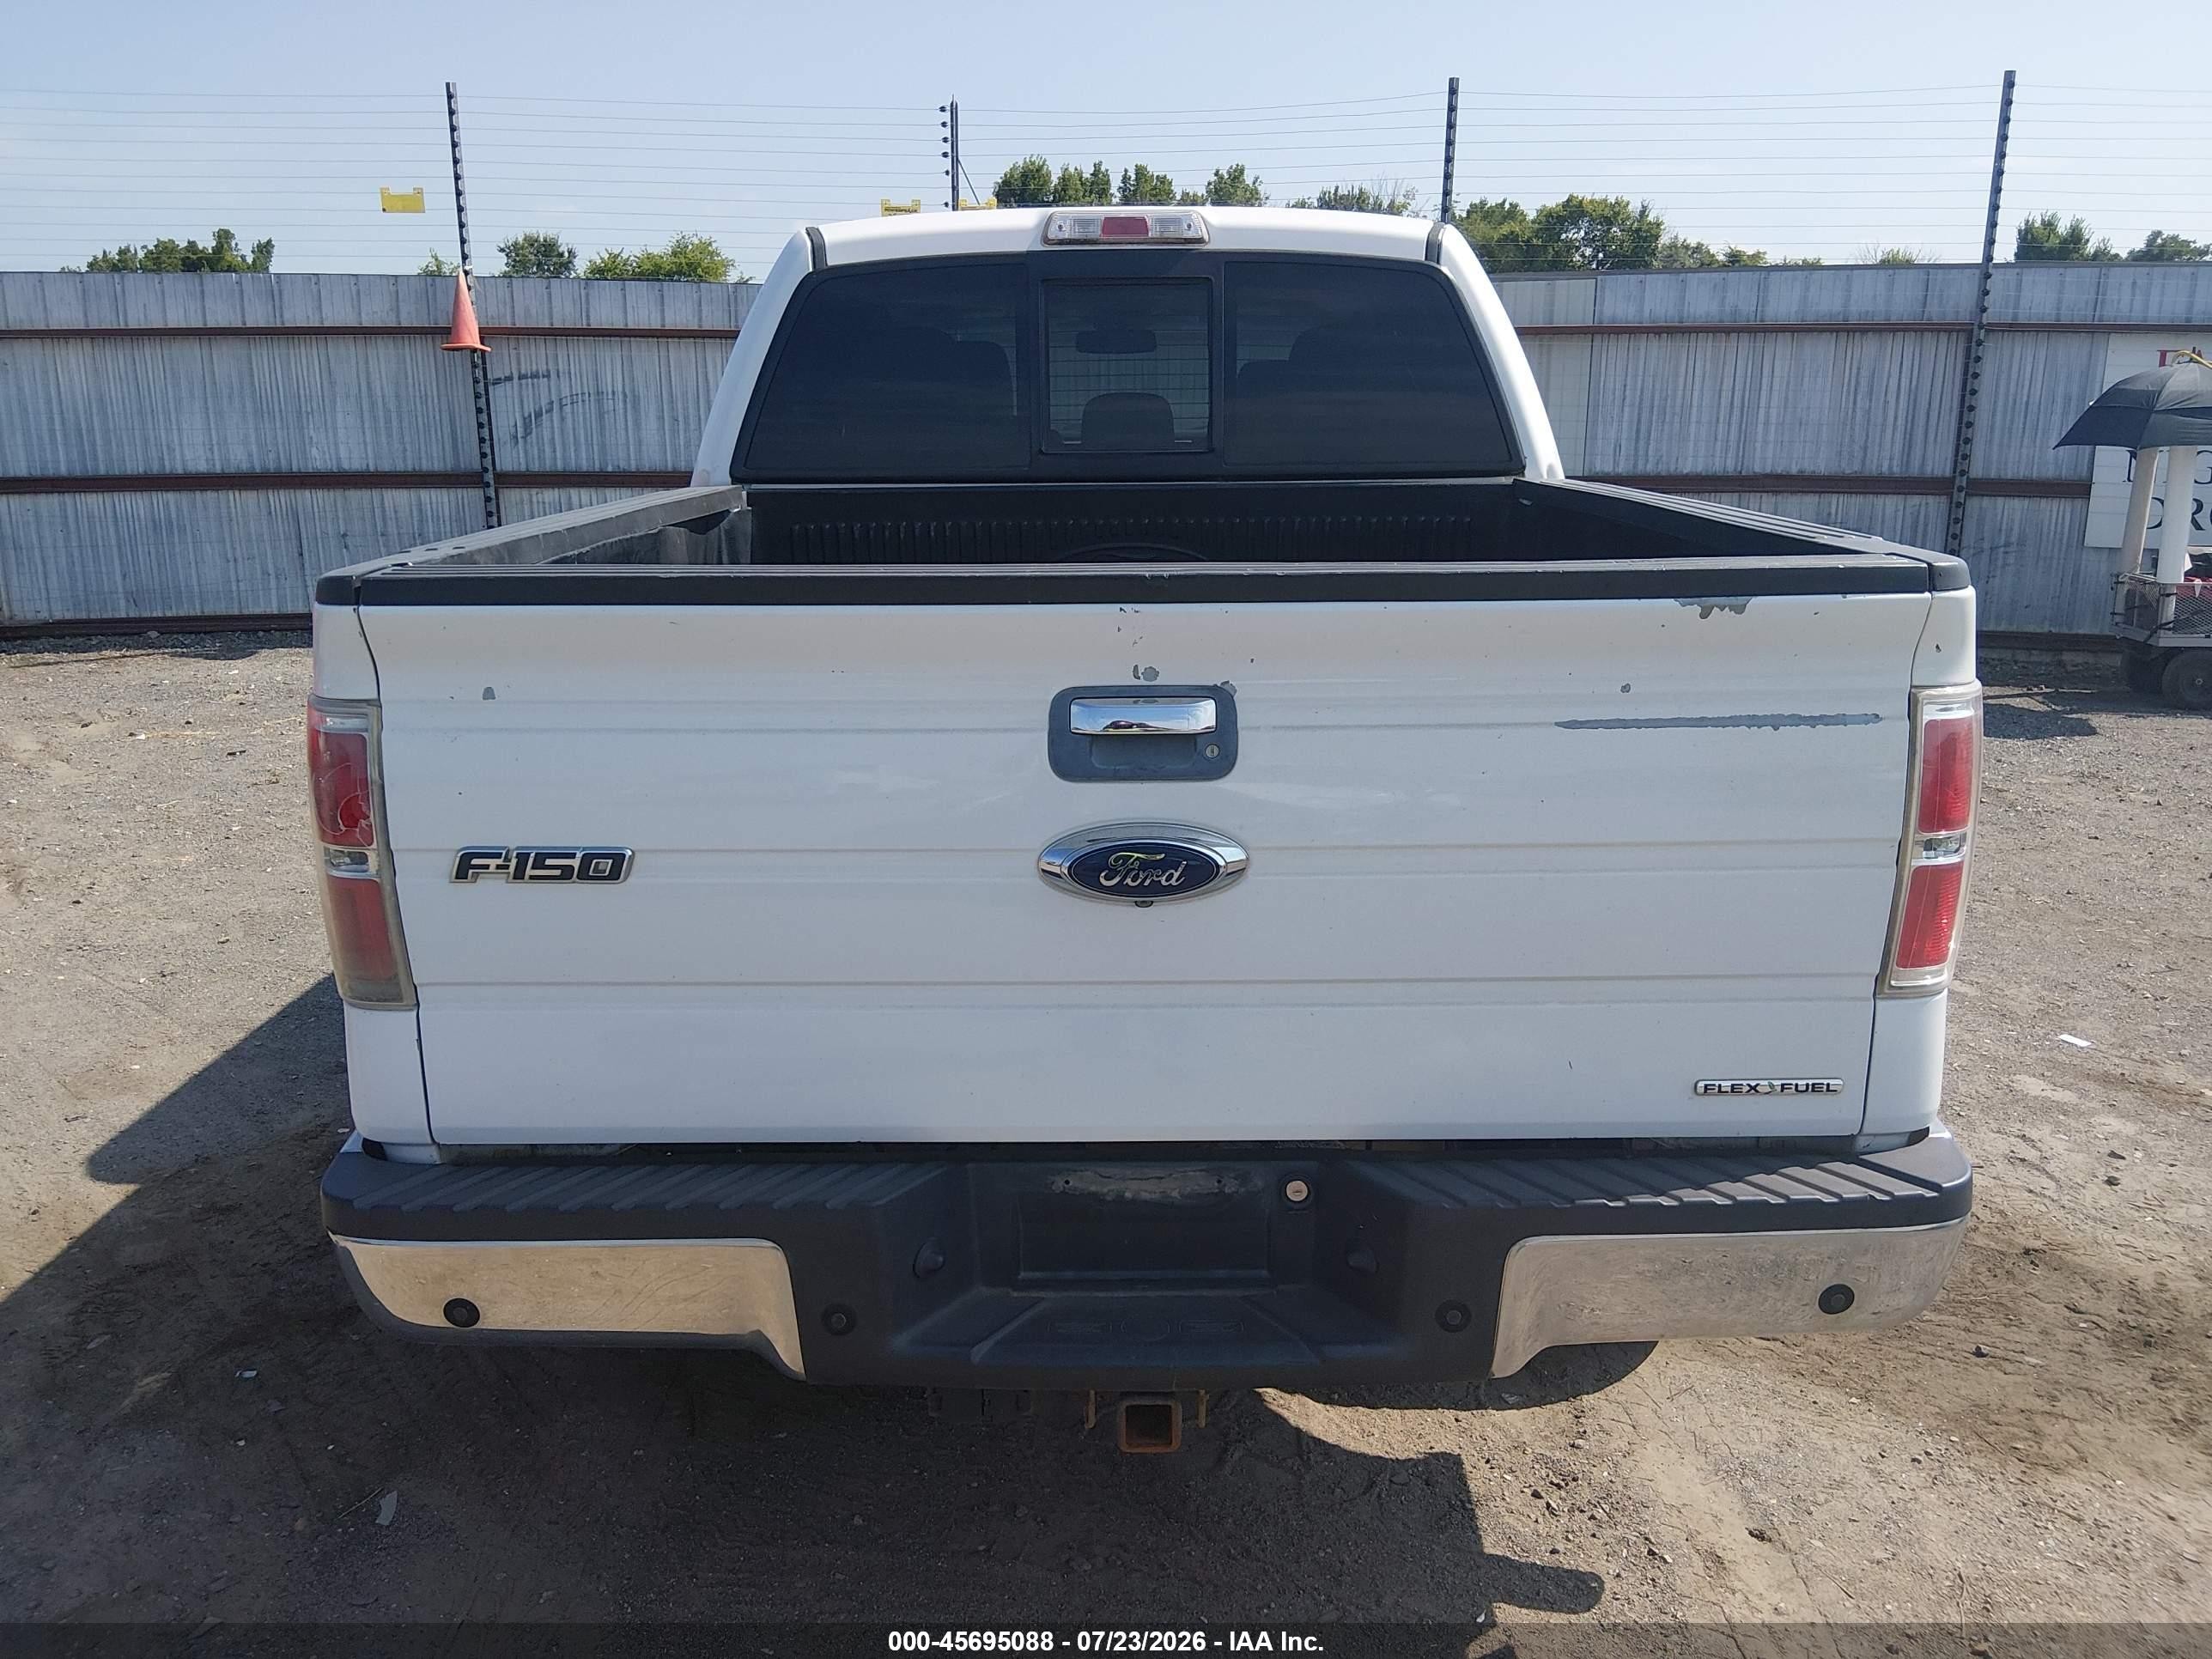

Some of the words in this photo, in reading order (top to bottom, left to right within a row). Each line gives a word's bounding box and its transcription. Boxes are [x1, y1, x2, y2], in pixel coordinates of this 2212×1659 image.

[449, 846, 635, 884] F-150
[1099, 852, 1188, 886] Ford
[1703, 1083, 1760, 1094] FLEX
[1780, 1082, 1838, 1093] FUEL
